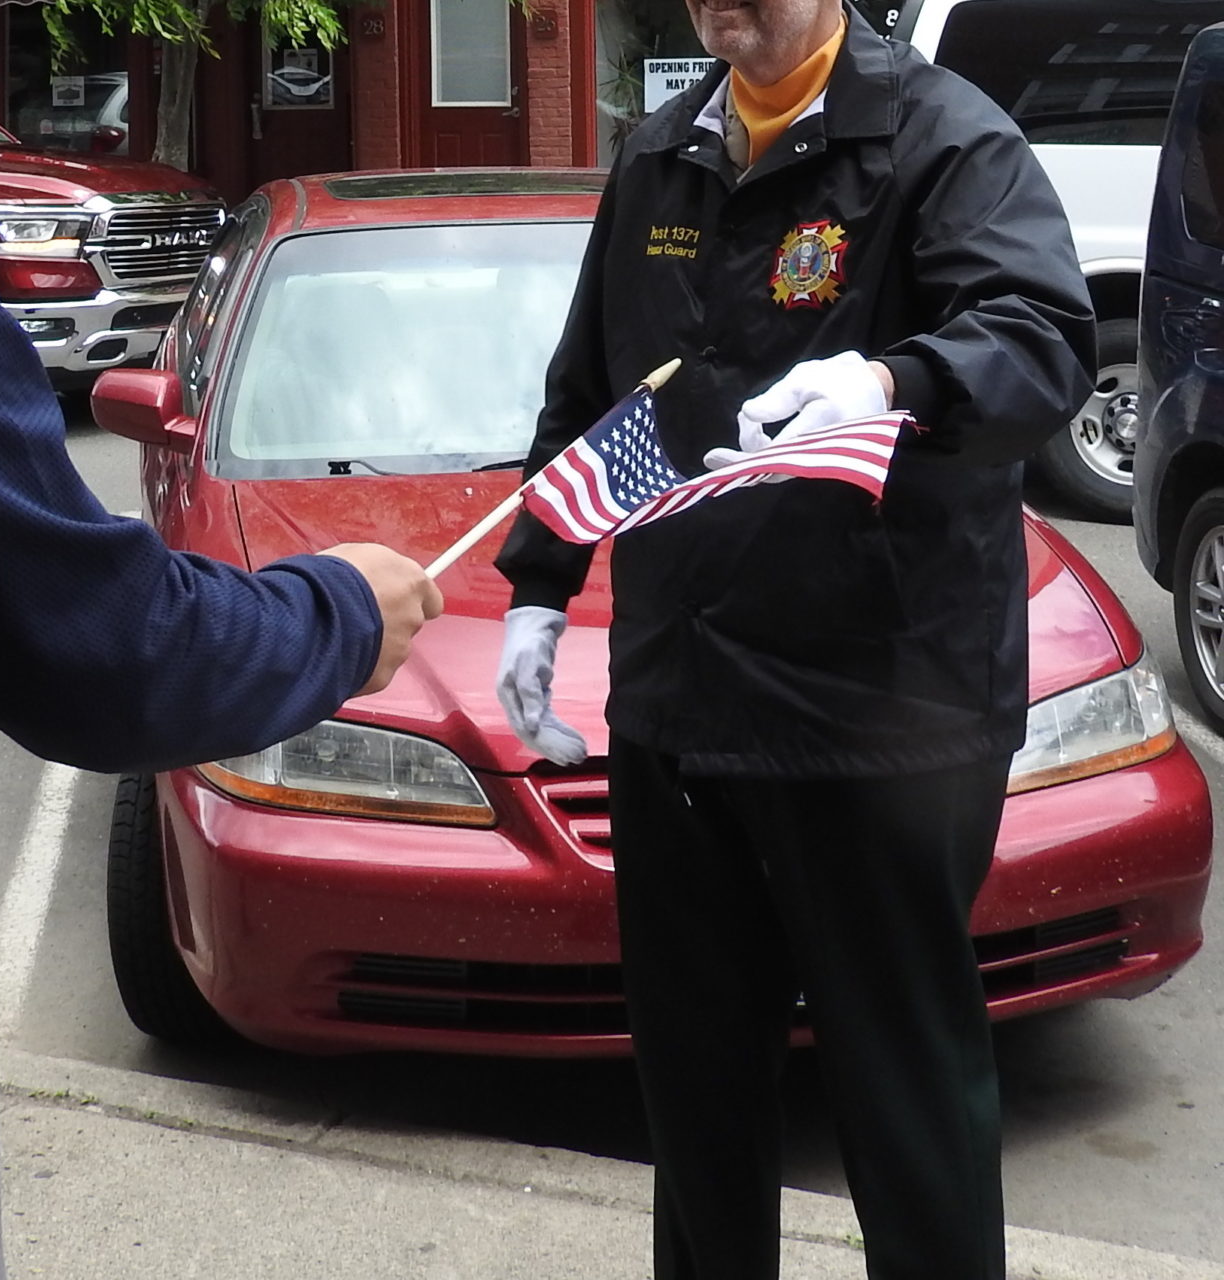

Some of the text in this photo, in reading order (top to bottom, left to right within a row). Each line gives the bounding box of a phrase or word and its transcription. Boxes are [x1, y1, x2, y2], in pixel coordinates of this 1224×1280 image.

[363, 19, 384, 35] 28
[648, 61, 690, 74] OPENING
[665, 78, 686, 90] MAY
[154, 229, 212, 246] RAM
[671, 226, 700, 243] 1371
[664, 242, 697, 259] Guard
